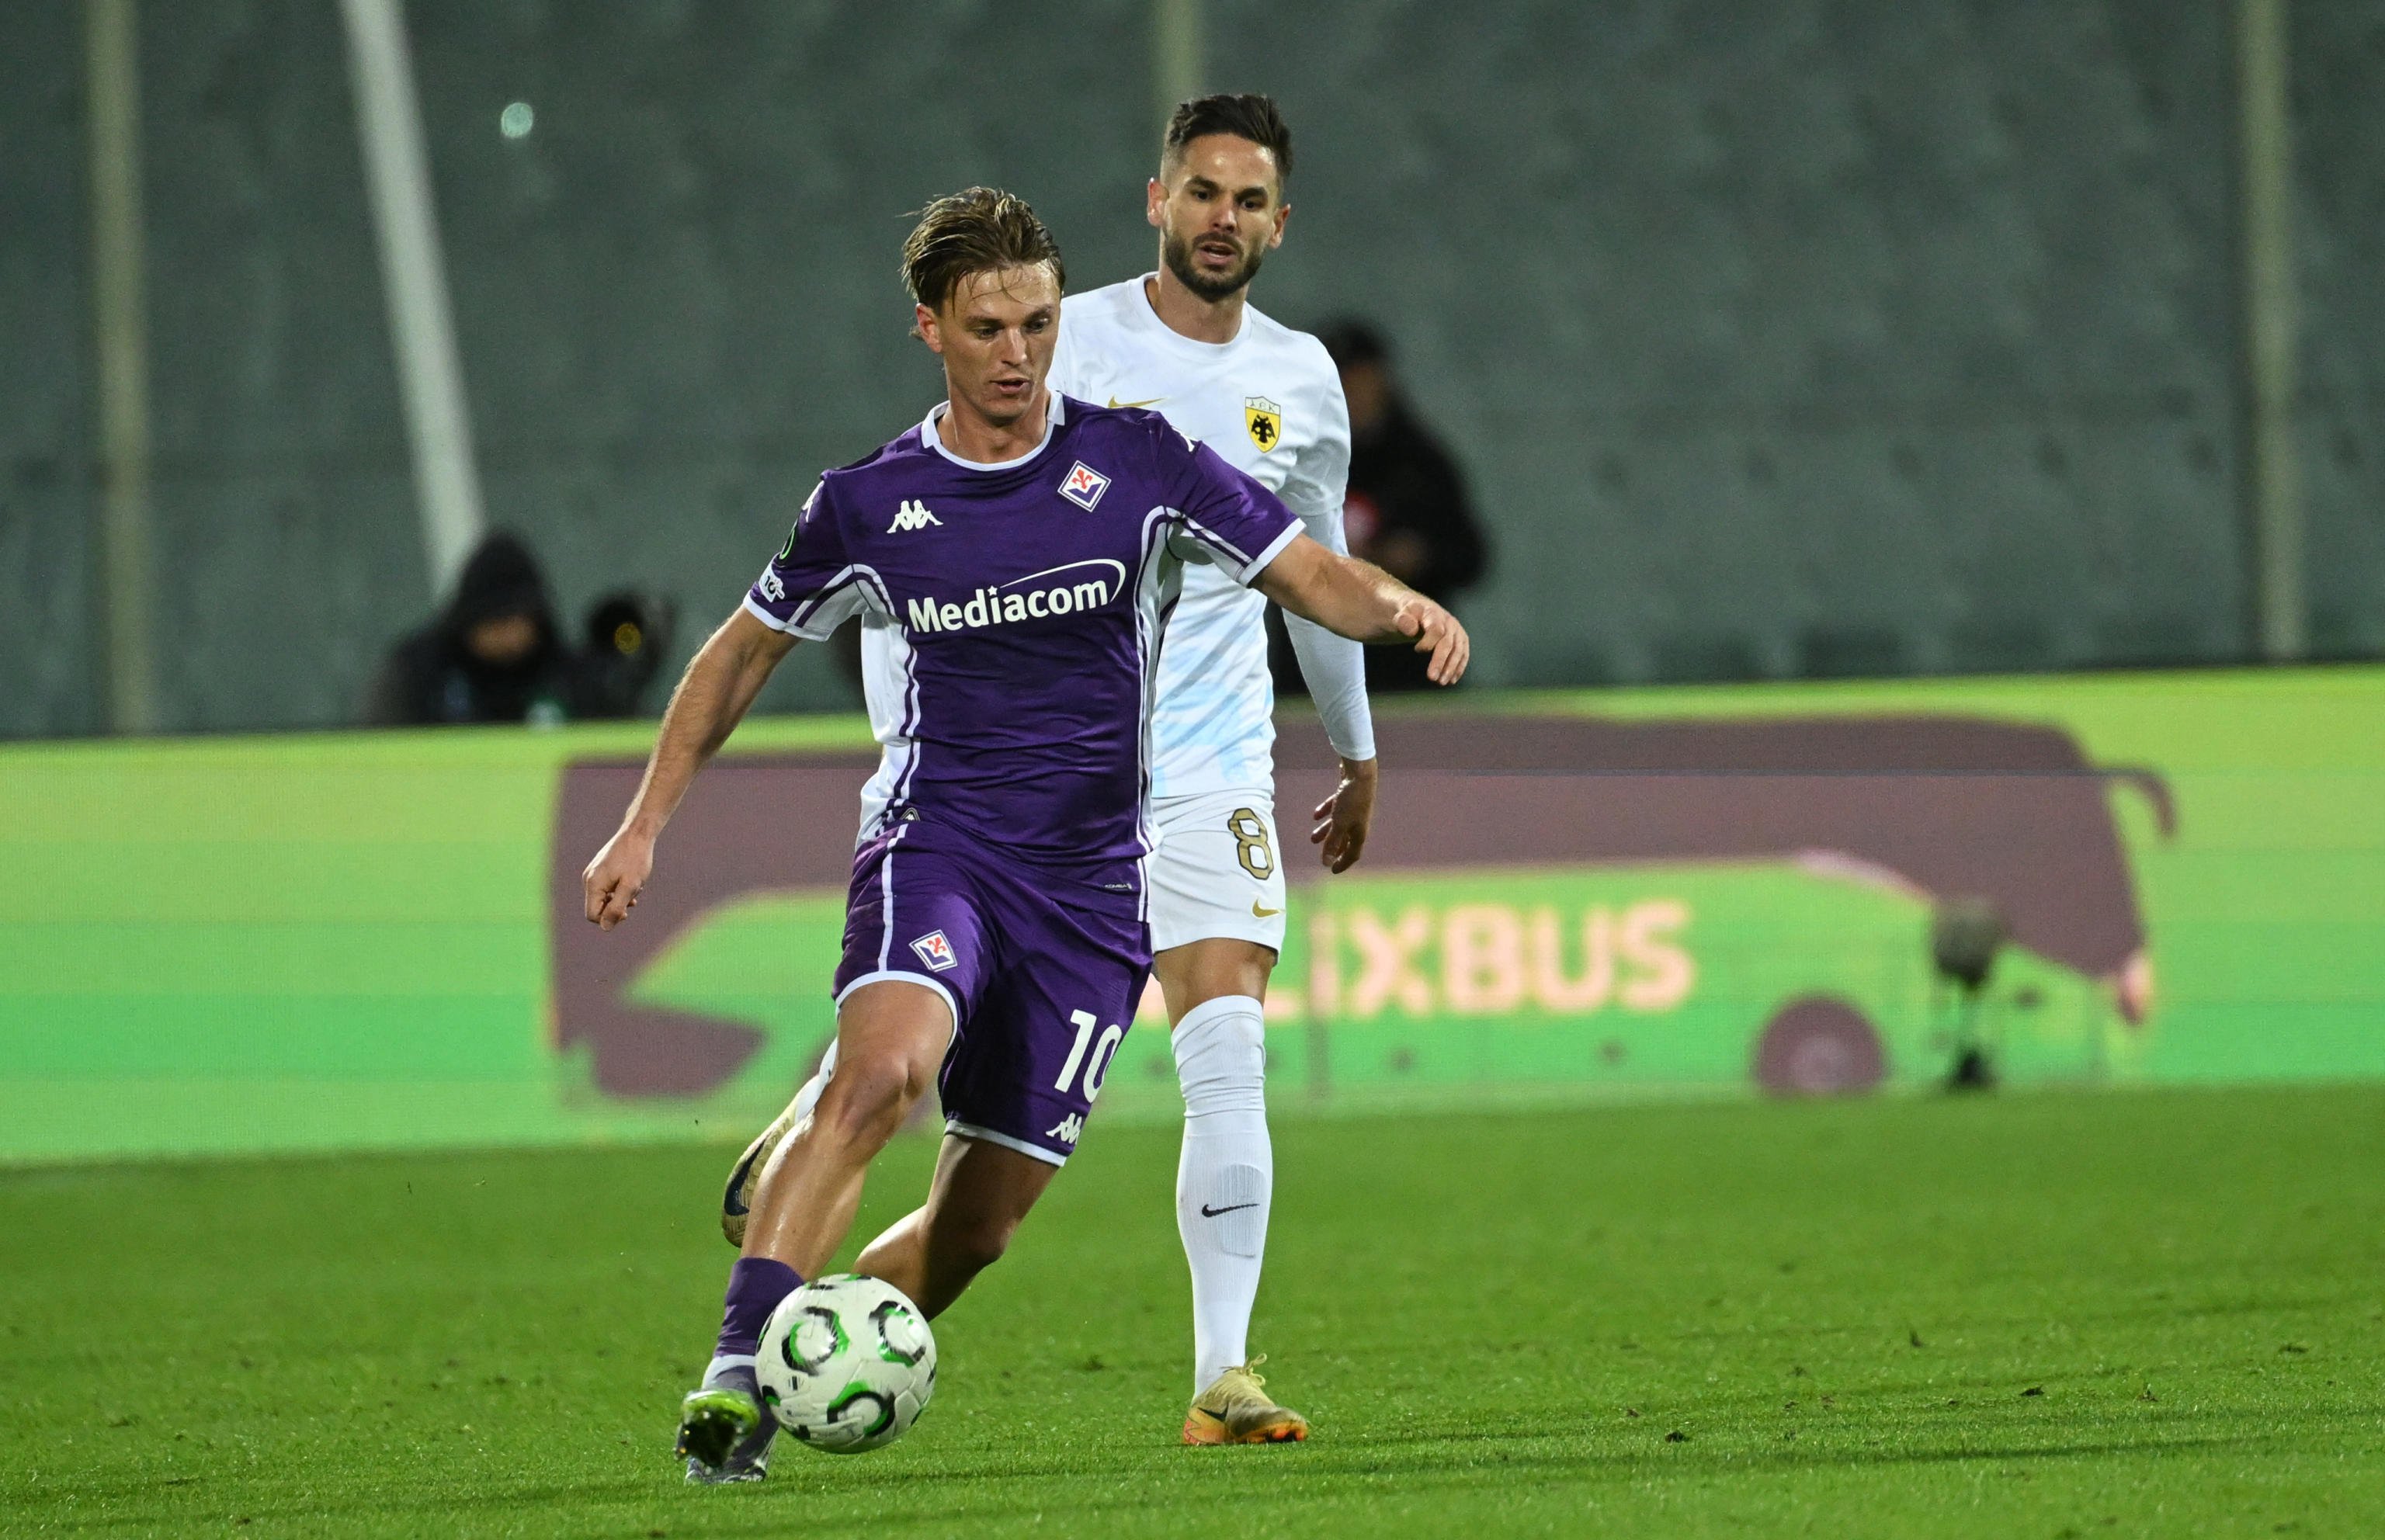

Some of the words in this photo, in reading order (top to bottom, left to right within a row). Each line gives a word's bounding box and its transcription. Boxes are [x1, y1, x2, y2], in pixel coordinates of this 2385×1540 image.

[908, 580, 1109, 633] Mediacom
[1227, 807, 1274, 880] 8
[1138, 899, 1695, 1023] IXBUS
[1054, 1008, 1123, 1103] 10
